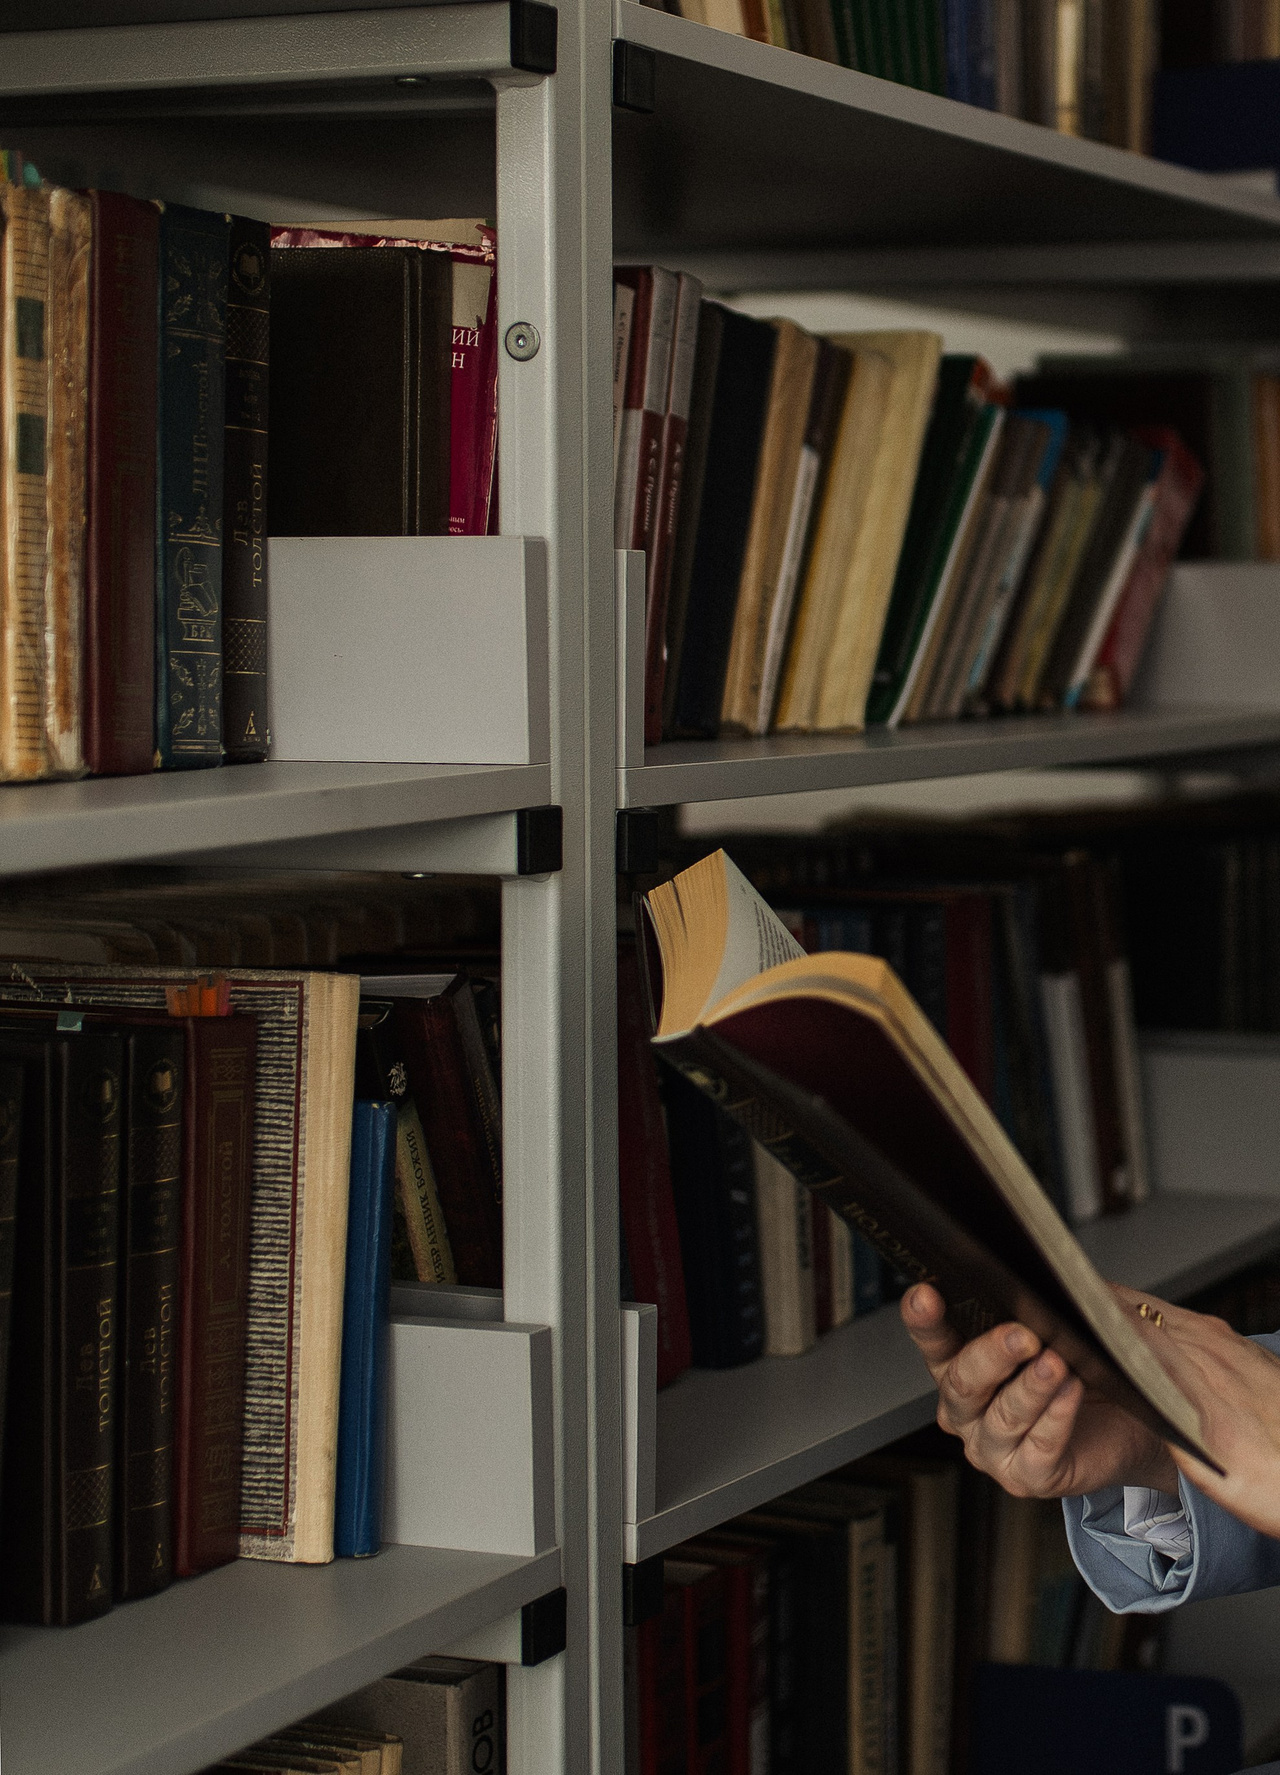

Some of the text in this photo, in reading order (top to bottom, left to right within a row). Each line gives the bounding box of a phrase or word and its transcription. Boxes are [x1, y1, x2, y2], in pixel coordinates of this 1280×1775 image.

[250, 462, 264, 588] ТОЛСТОЙ
[217, 1140, 233, 1242] ТОЛСТОЙ
[405, 1129, 447, 1284] ИЗБРАННИК БОЖИЙ
[96, 1297, 113, 1433] ТОЛСТОЙ
[158, 1283, 172, 1414] ТОЛСТОЙ
[471, 1708, 493, 1775] ОВ
